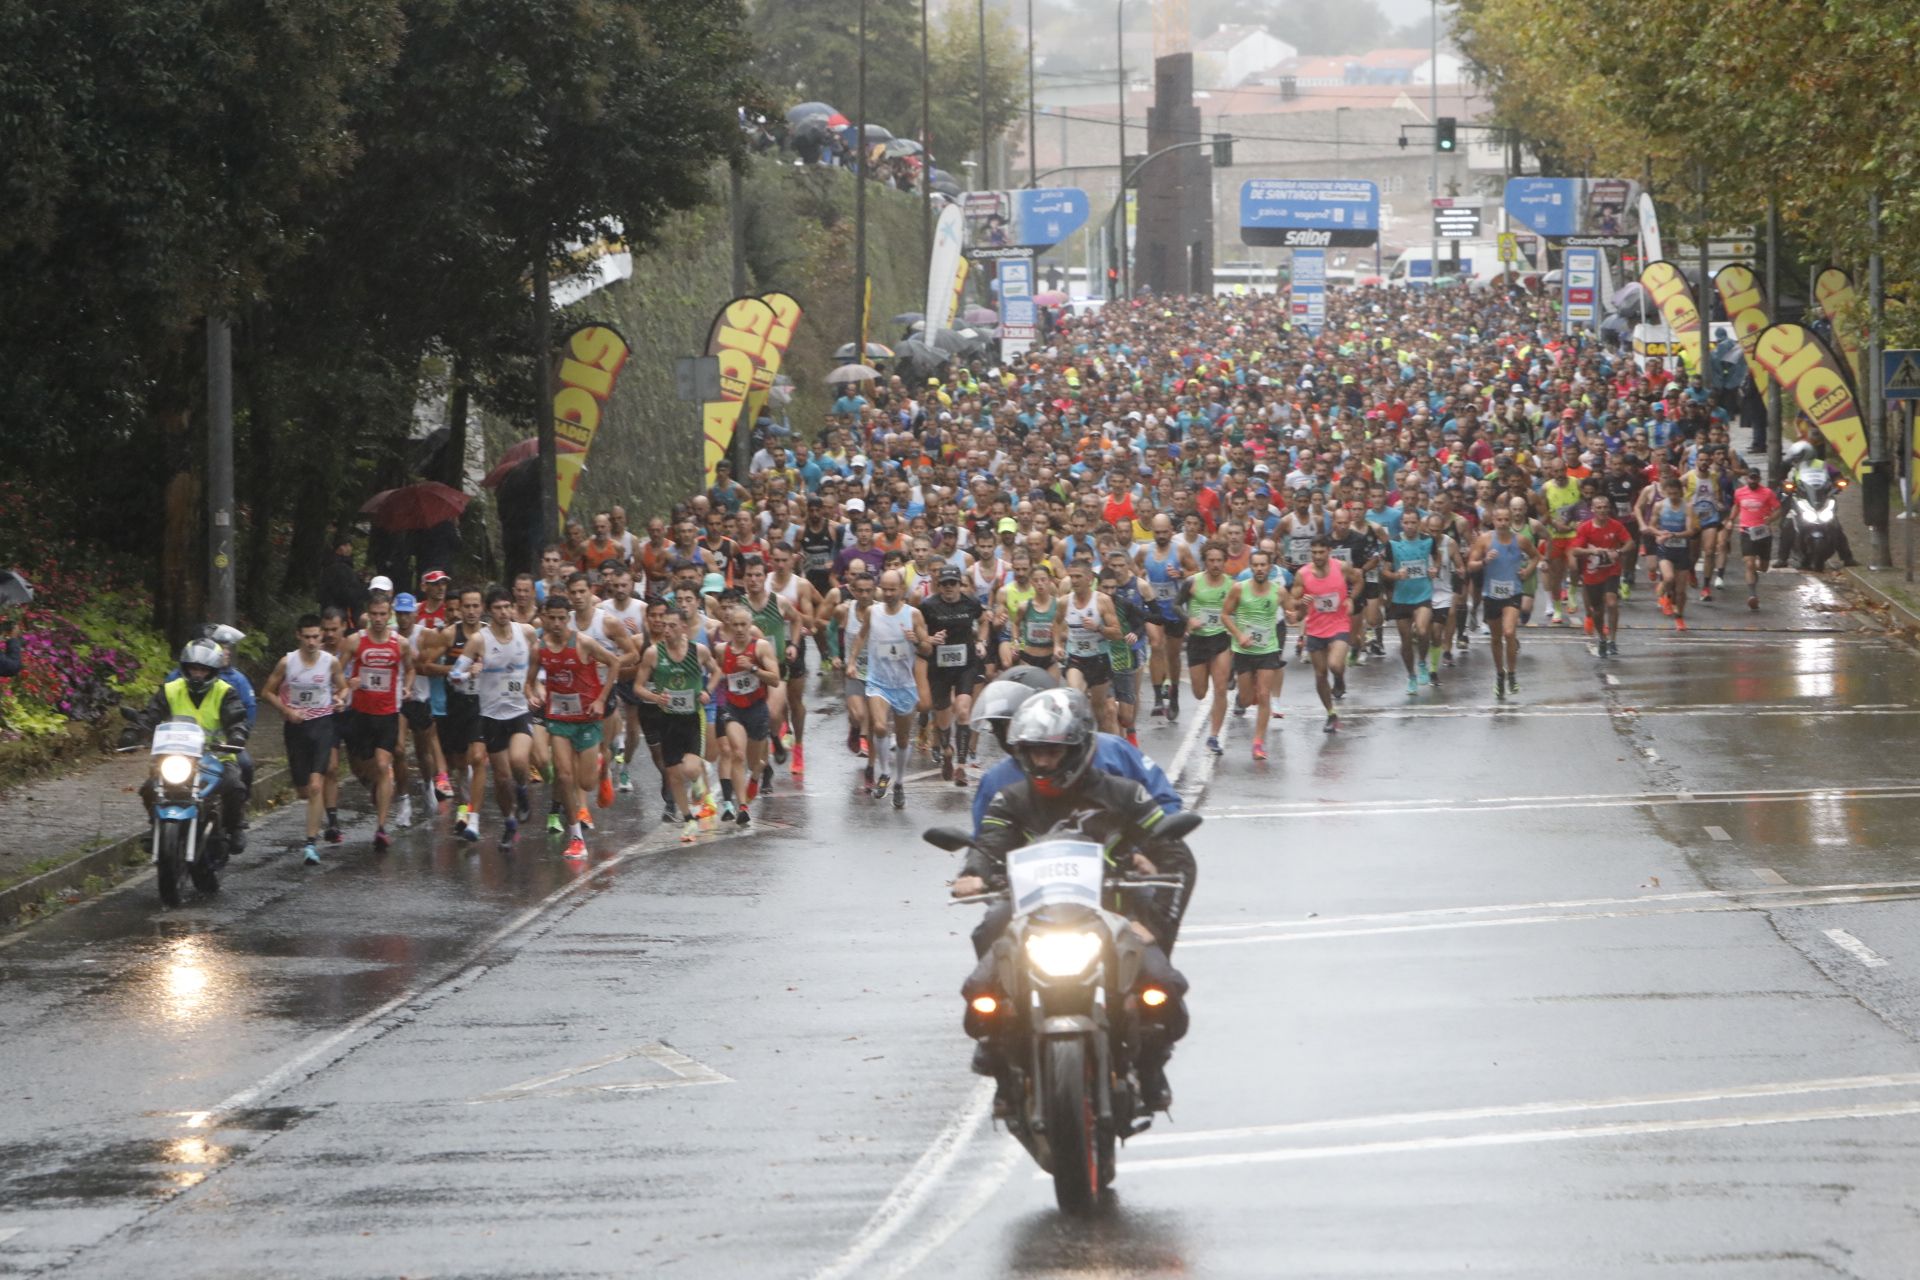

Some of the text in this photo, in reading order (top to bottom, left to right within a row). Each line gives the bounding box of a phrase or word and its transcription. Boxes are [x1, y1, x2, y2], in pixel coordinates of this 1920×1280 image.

[1264, 190, 1317, 200] SANTIAGO
[1284, 228, 1332, 245] SAÍDA
[299, 691, 313, 702] 97
